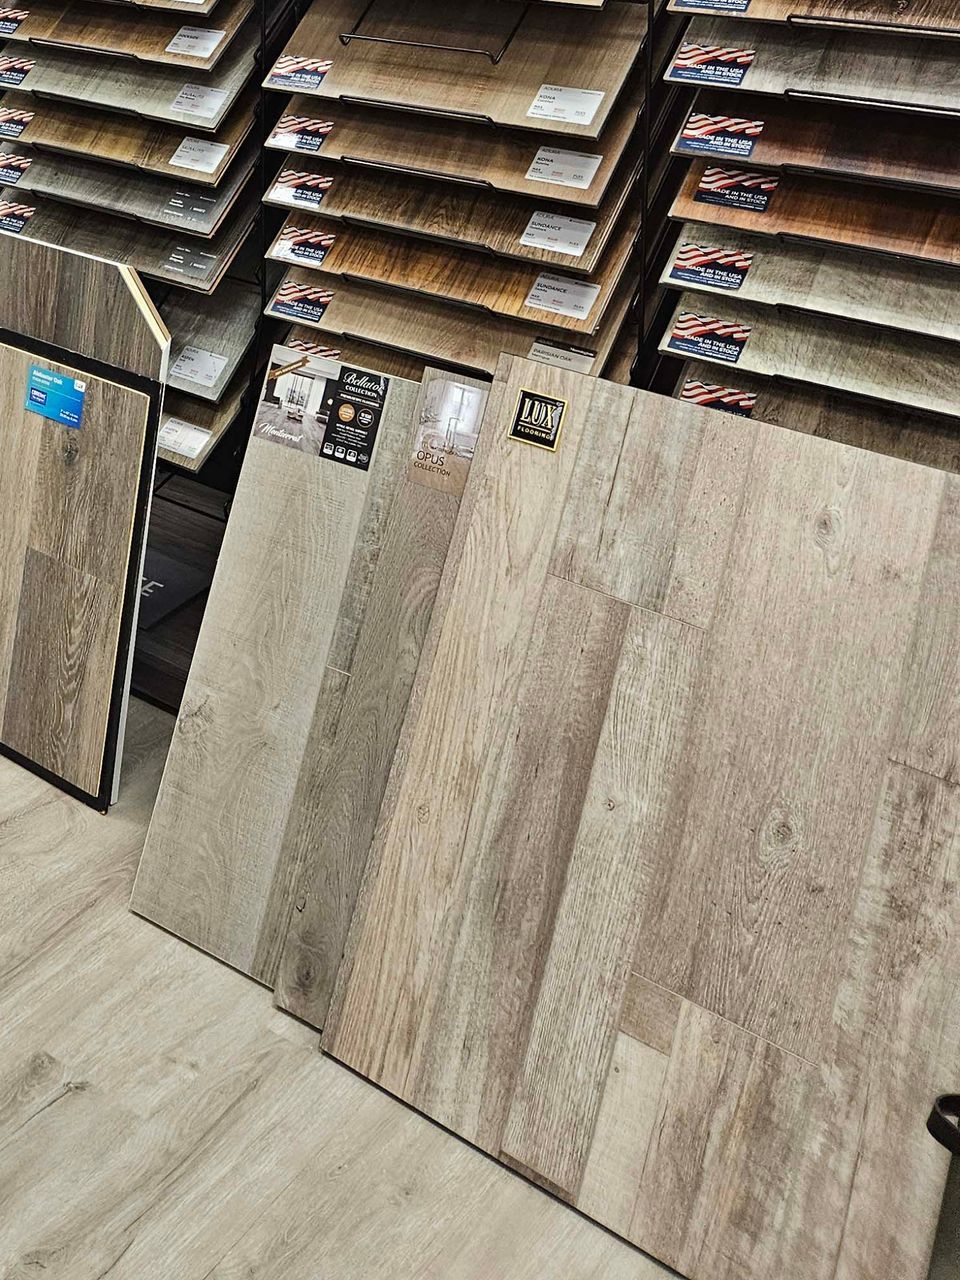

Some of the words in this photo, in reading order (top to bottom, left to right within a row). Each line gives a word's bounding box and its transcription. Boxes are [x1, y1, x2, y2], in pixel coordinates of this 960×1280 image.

[531, 221, 562, 230] SUNDANCE
[536, 282, 568, 294] SUNDANCE
[345, 385, 377, 398] COLLECTION
[520, 398, 557, 429] LUX
[517, 426, 550, 439] FLOORING
[417, 450, 444, 466] OPUS
[414, 461, 450, 476] COLLECTION
